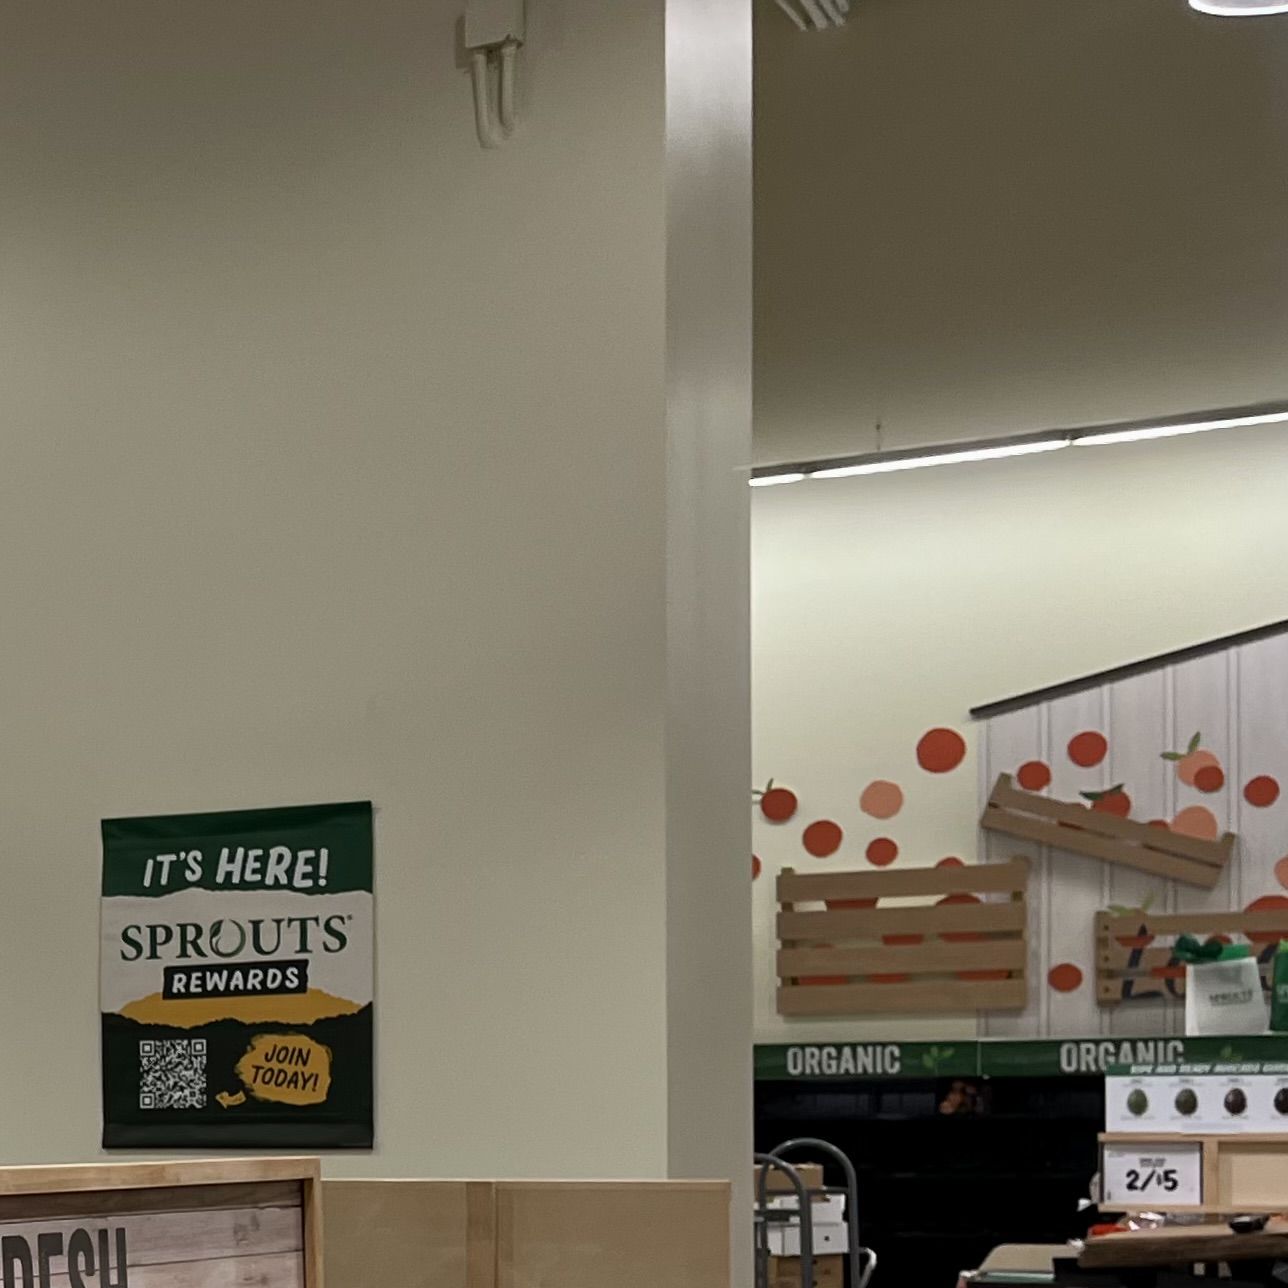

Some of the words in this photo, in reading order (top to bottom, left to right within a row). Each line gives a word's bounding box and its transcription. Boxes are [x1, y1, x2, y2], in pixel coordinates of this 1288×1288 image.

[143, 849, 204, 888] IT'S
[215, 845, 330, 889] HERE!
[119, 914, 350, 962] SPROUTS
[171, 966, 301, 995] REWARDS
[264, 1044, 312, 1067] JOIN
[786, 1045, 902, 1075] ORGANIC
[1059, 1039, 1185, 1073] ORGANIC
[251, 1064, 319, 1093] TODAY!
